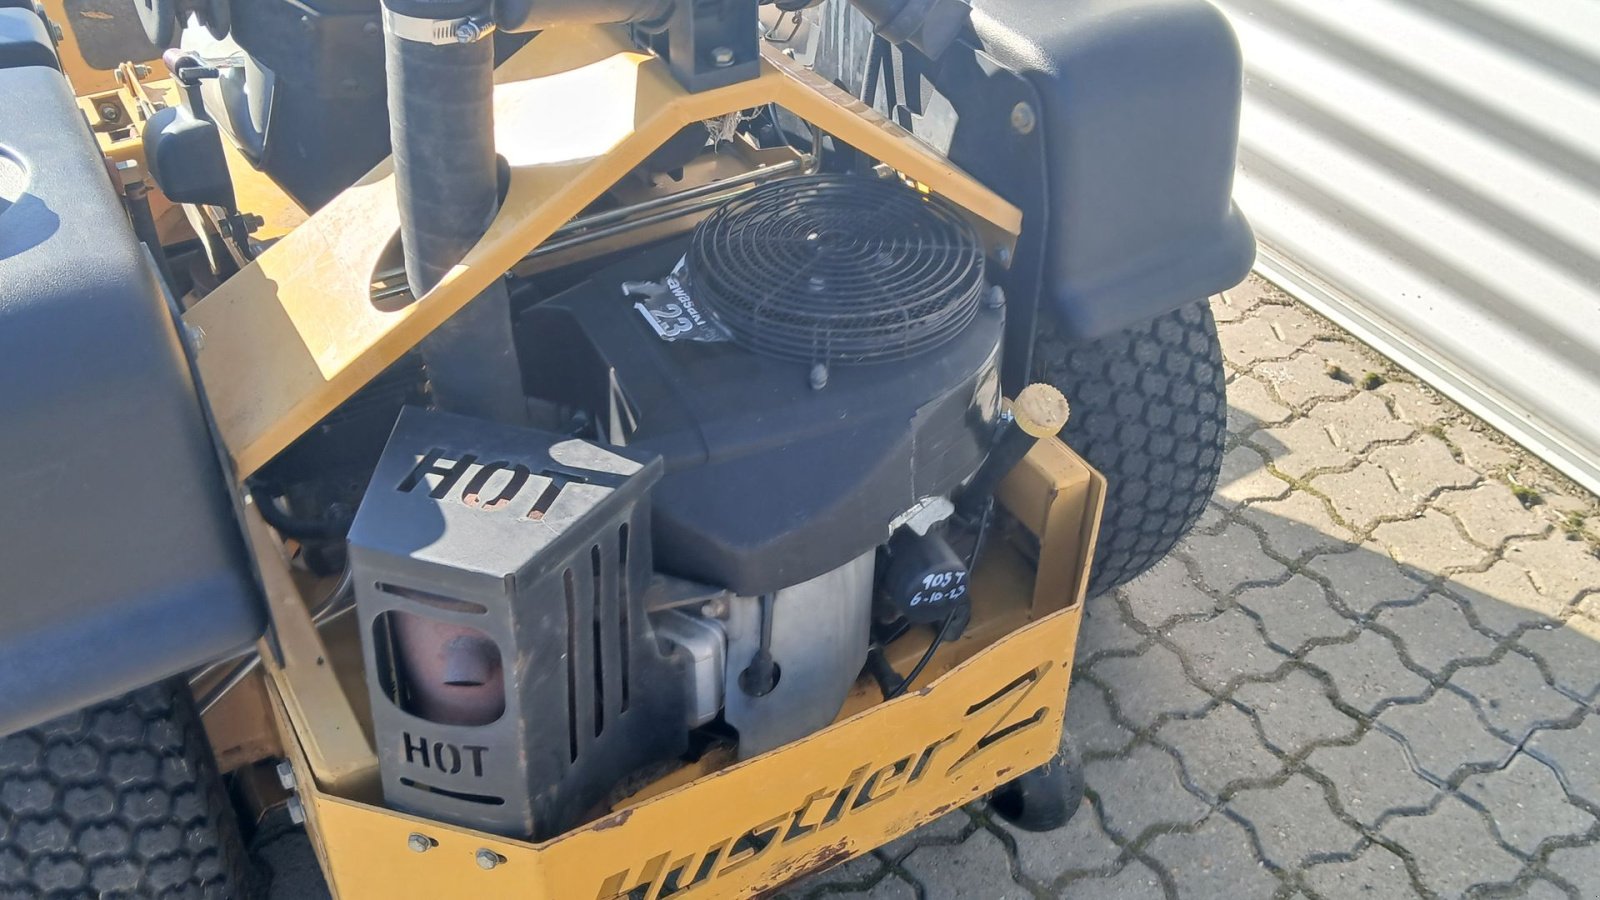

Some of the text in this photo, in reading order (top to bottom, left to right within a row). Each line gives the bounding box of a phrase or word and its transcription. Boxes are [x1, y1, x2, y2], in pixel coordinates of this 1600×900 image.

[650, 303, 693, 337] 23
[666, 274, 706, 326] awasaki
[396, 447, 588, 521] HOT
[946, 660, 1053, 778] Z
[403, 731, 489, 777] HOT
